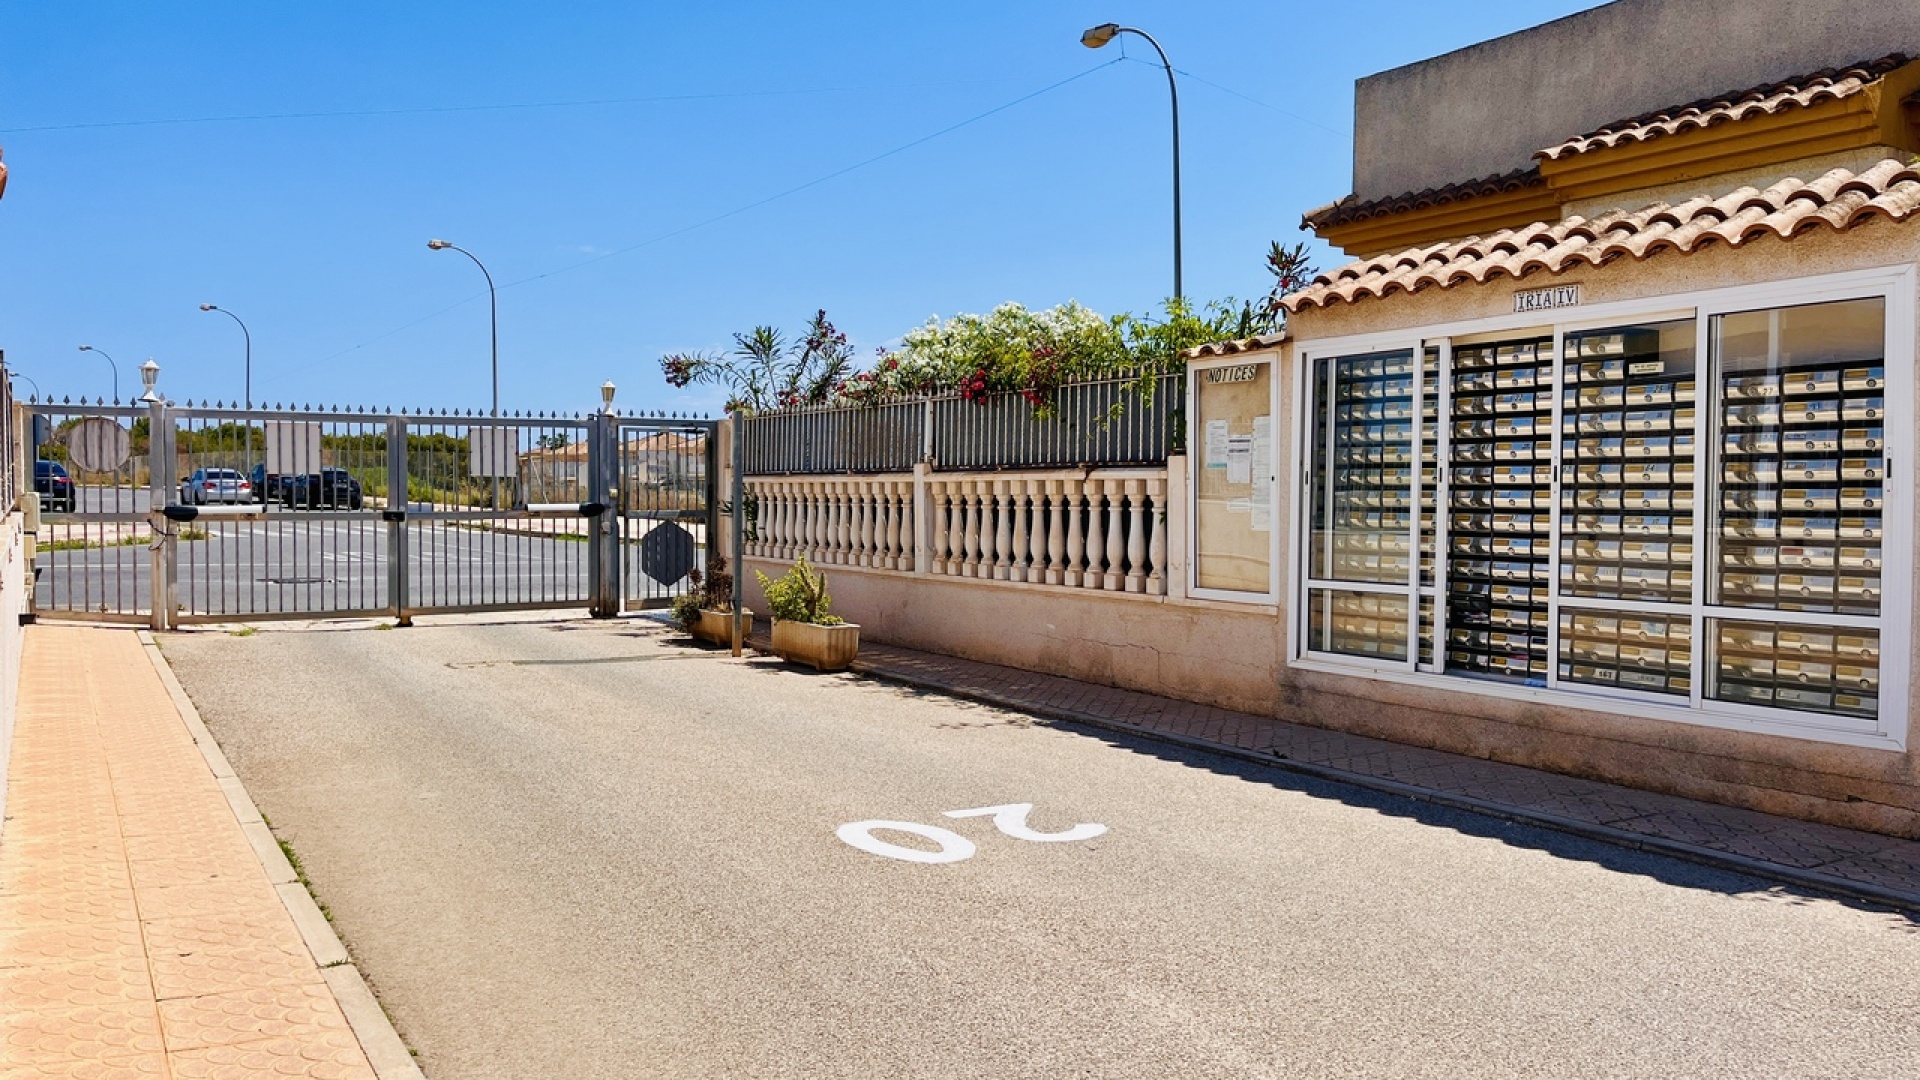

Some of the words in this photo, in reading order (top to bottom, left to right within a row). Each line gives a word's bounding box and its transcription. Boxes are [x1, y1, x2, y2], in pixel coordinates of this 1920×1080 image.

[1518, 292, 1552, 309] IRIA
[1558, 289, 1575, 304] IV
[1208, 365, 1255, 383] NOTICES
[836, 803, 1109, 864] 20
